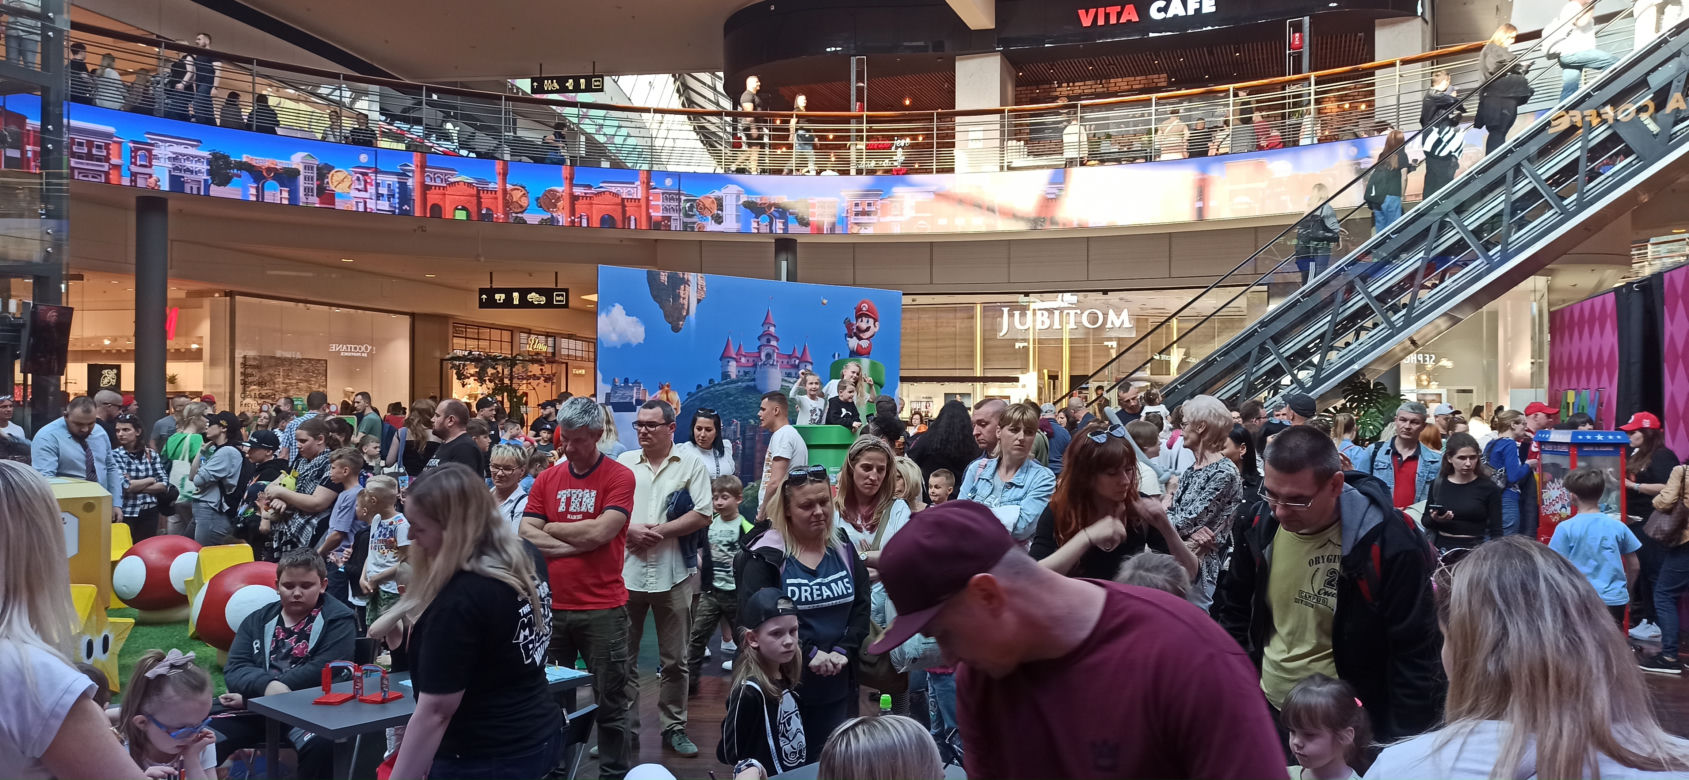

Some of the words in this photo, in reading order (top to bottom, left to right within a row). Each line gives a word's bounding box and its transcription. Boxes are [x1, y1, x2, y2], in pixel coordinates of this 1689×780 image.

[1078, 4, 1140, 27] VITA
[999, 306, 1134, 337] JUBITOM
[556, 489, 597, 513] TRN
[787, 578, 853, 602] DREAMS
